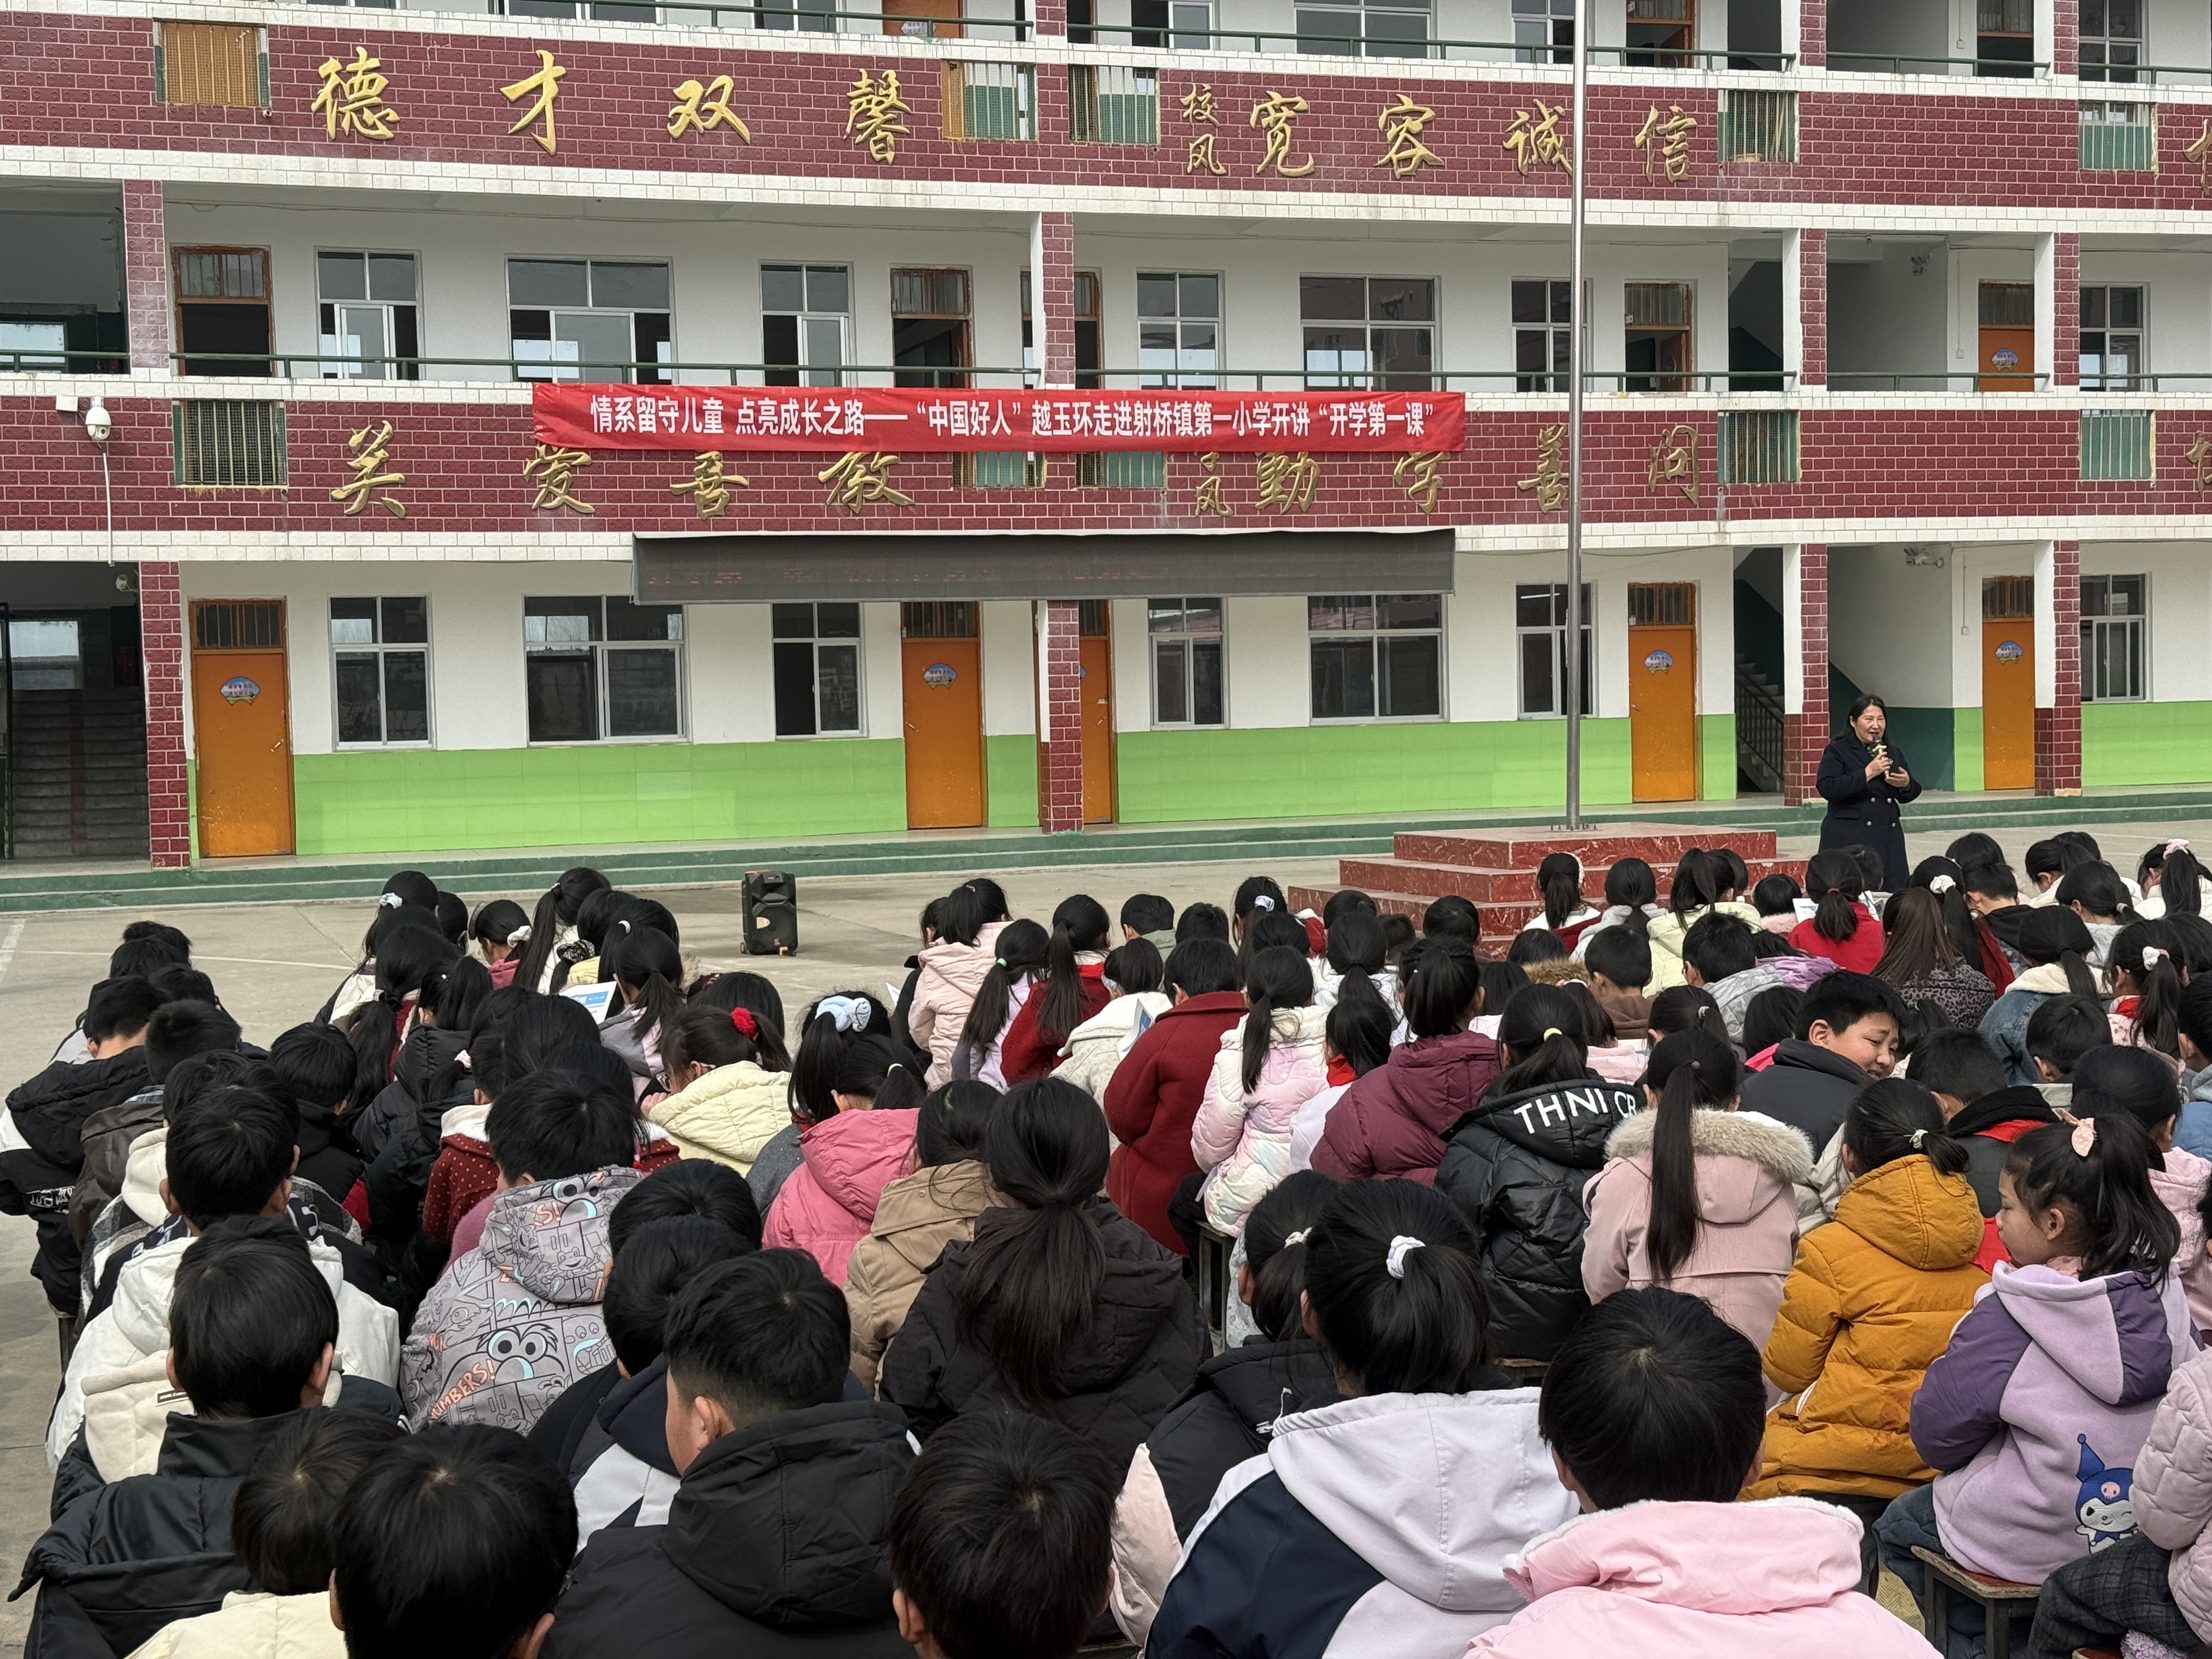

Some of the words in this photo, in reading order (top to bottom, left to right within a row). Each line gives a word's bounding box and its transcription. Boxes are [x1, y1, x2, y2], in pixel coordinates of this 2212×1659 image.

[311, 46, 911, 165] 德才双馨
[1181, 84, 1227, 175] 校风
[1250, 91, 1698, 183] 宽容诚信
[590, 395, 725, 434] 情系留守儿童
